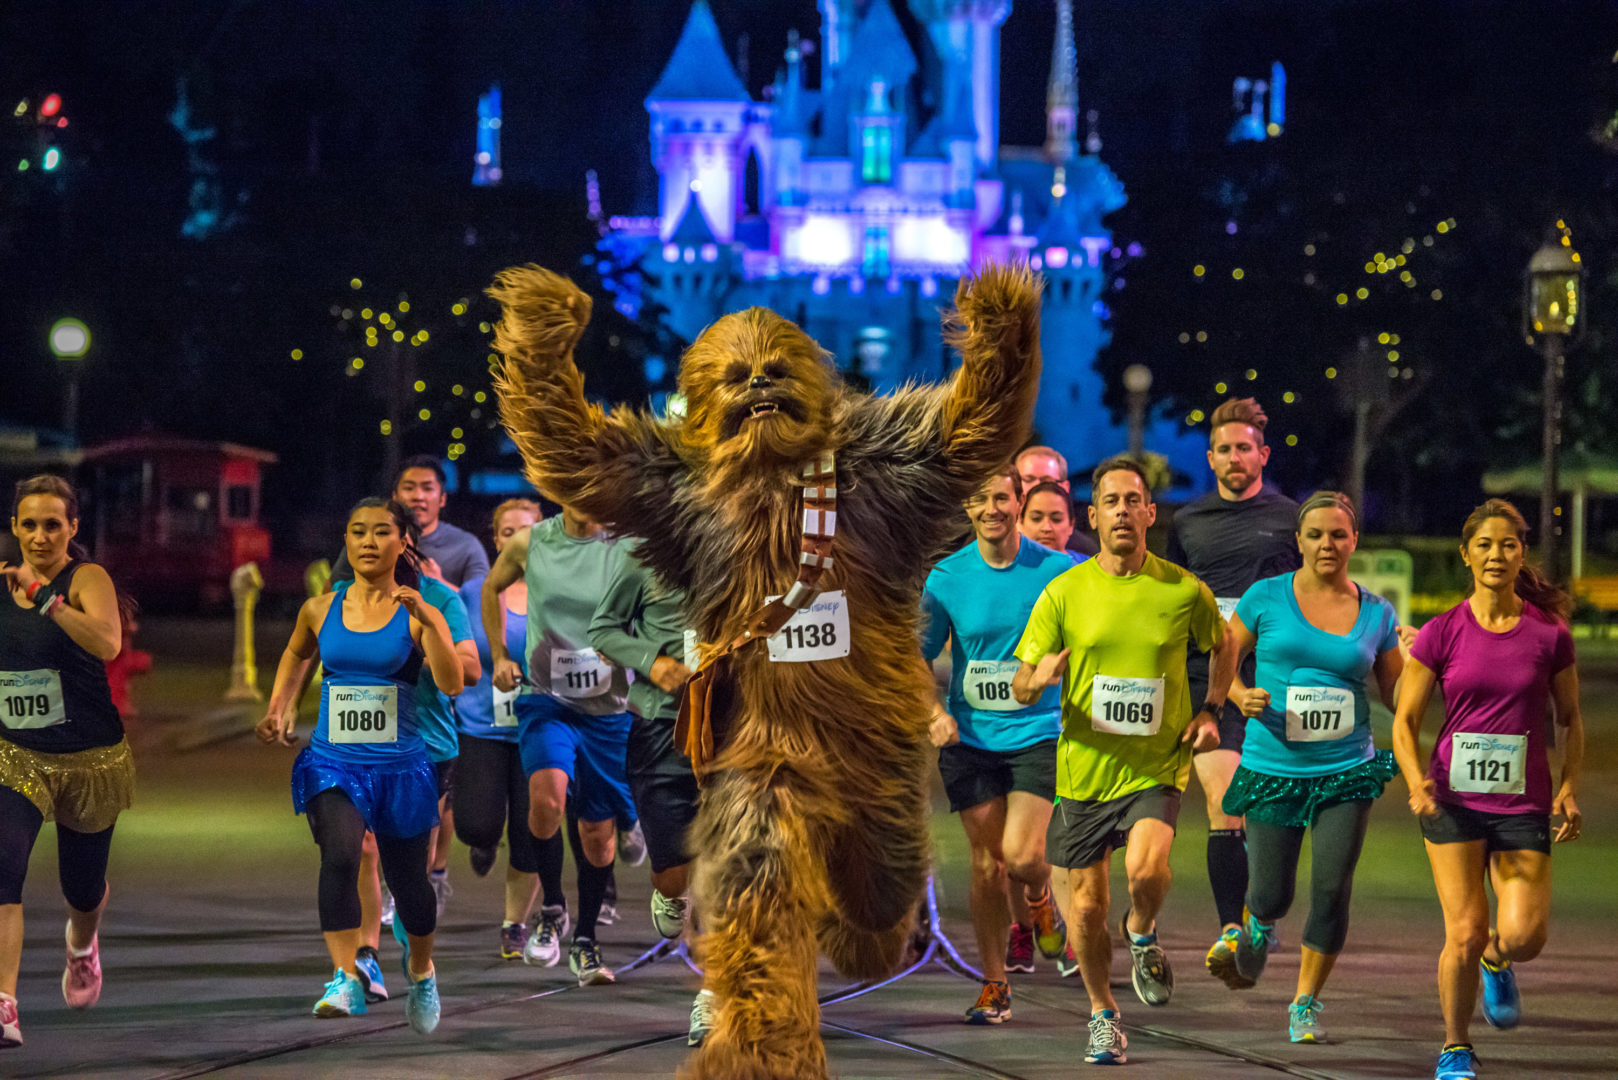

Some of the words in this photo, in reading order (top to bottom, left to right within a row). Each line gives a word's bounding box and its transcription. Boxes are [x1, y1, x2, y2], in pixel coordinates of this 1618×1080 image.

[781, 622, 837, 649] 1138
[565, 668, 599, 689] 1111
[975, 681, 1013, 701] 108
[4, 694, 50, 717] 1079
[1102, 700, 1154, 724] 1069
[337, 709, 386, 732] 1080
[1299, 710, 1342, 731] 1077
[1466, 759, 1511, 782] 1121
